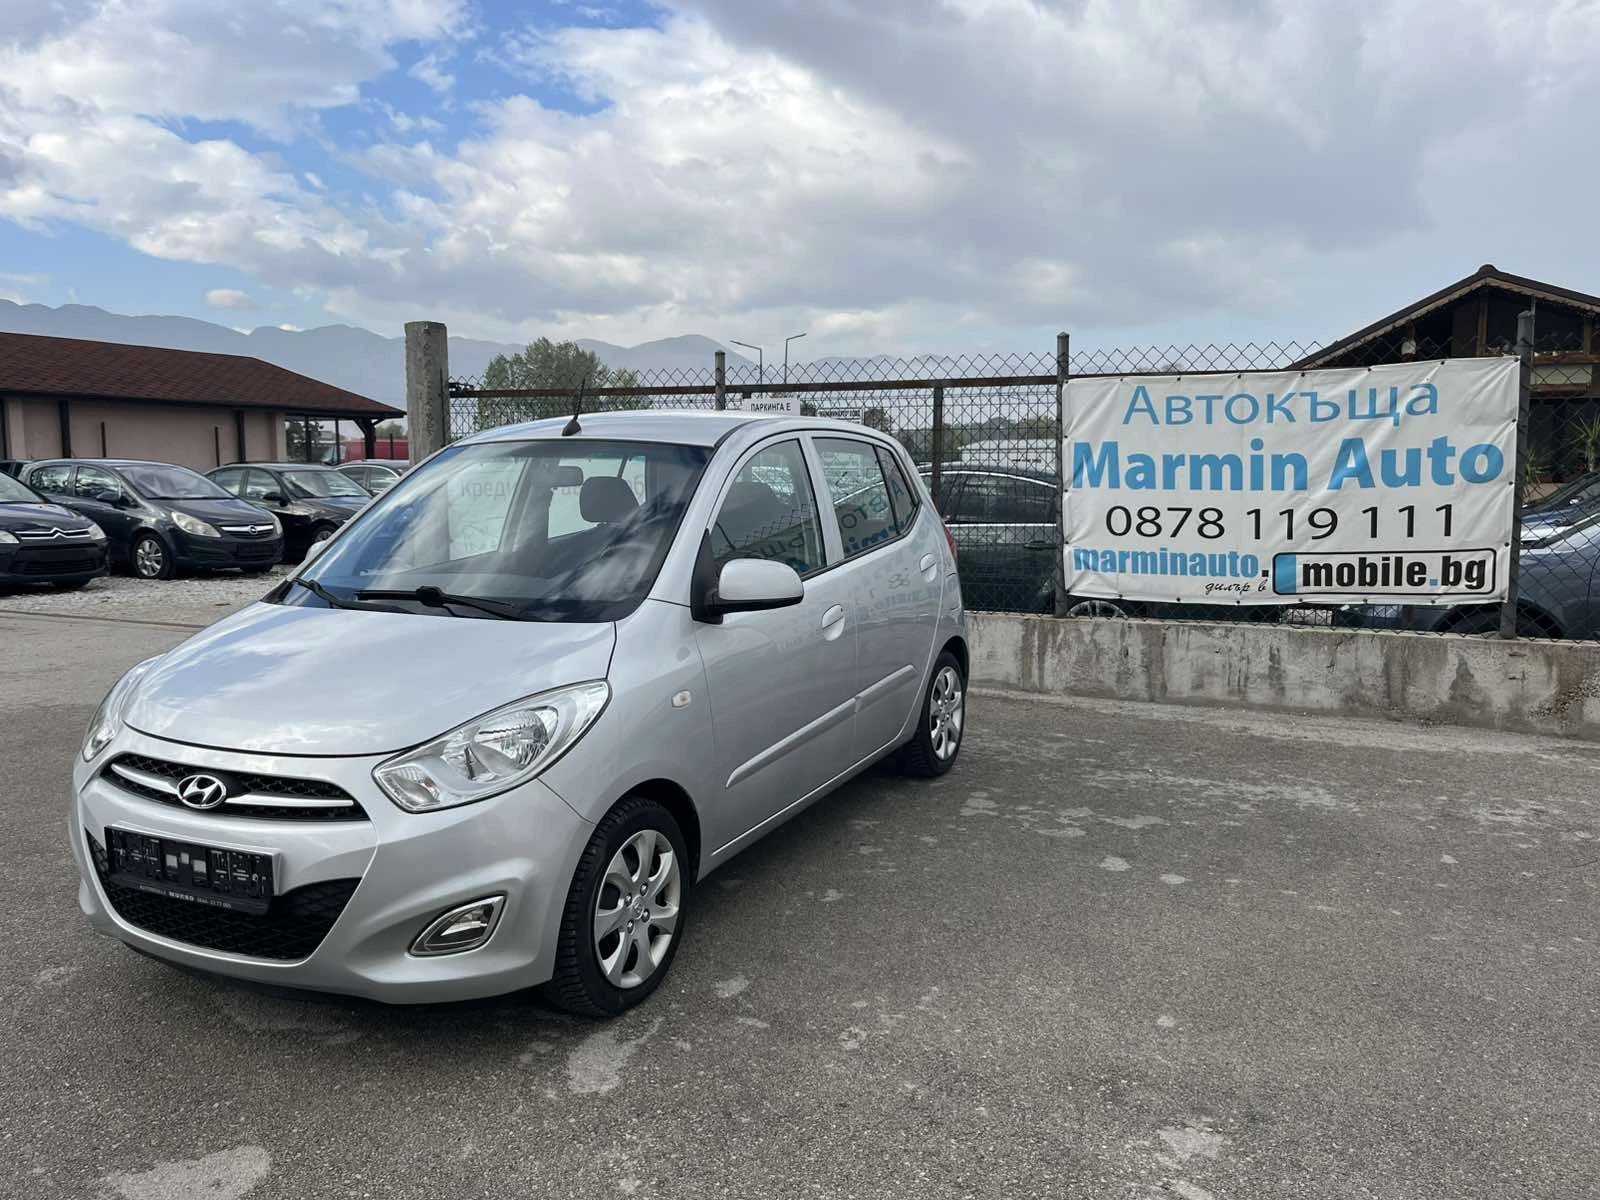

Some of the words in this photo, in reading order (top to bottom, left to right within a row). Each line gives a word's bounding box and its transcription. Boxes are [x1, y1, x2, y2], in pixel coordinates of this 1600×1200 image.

[1122, 383, 1439, 427] Автокъща
[1072, 438, 1308, 491] Marmin
[1327, 436, 1504, 490] Auto
[1105, 505, 1226, 539] 0878
[1246, 507, 1338, 540] 119
[1362, 504, 1453, 538] 111
[1302, 555, 1487, 590] mobile.bg
